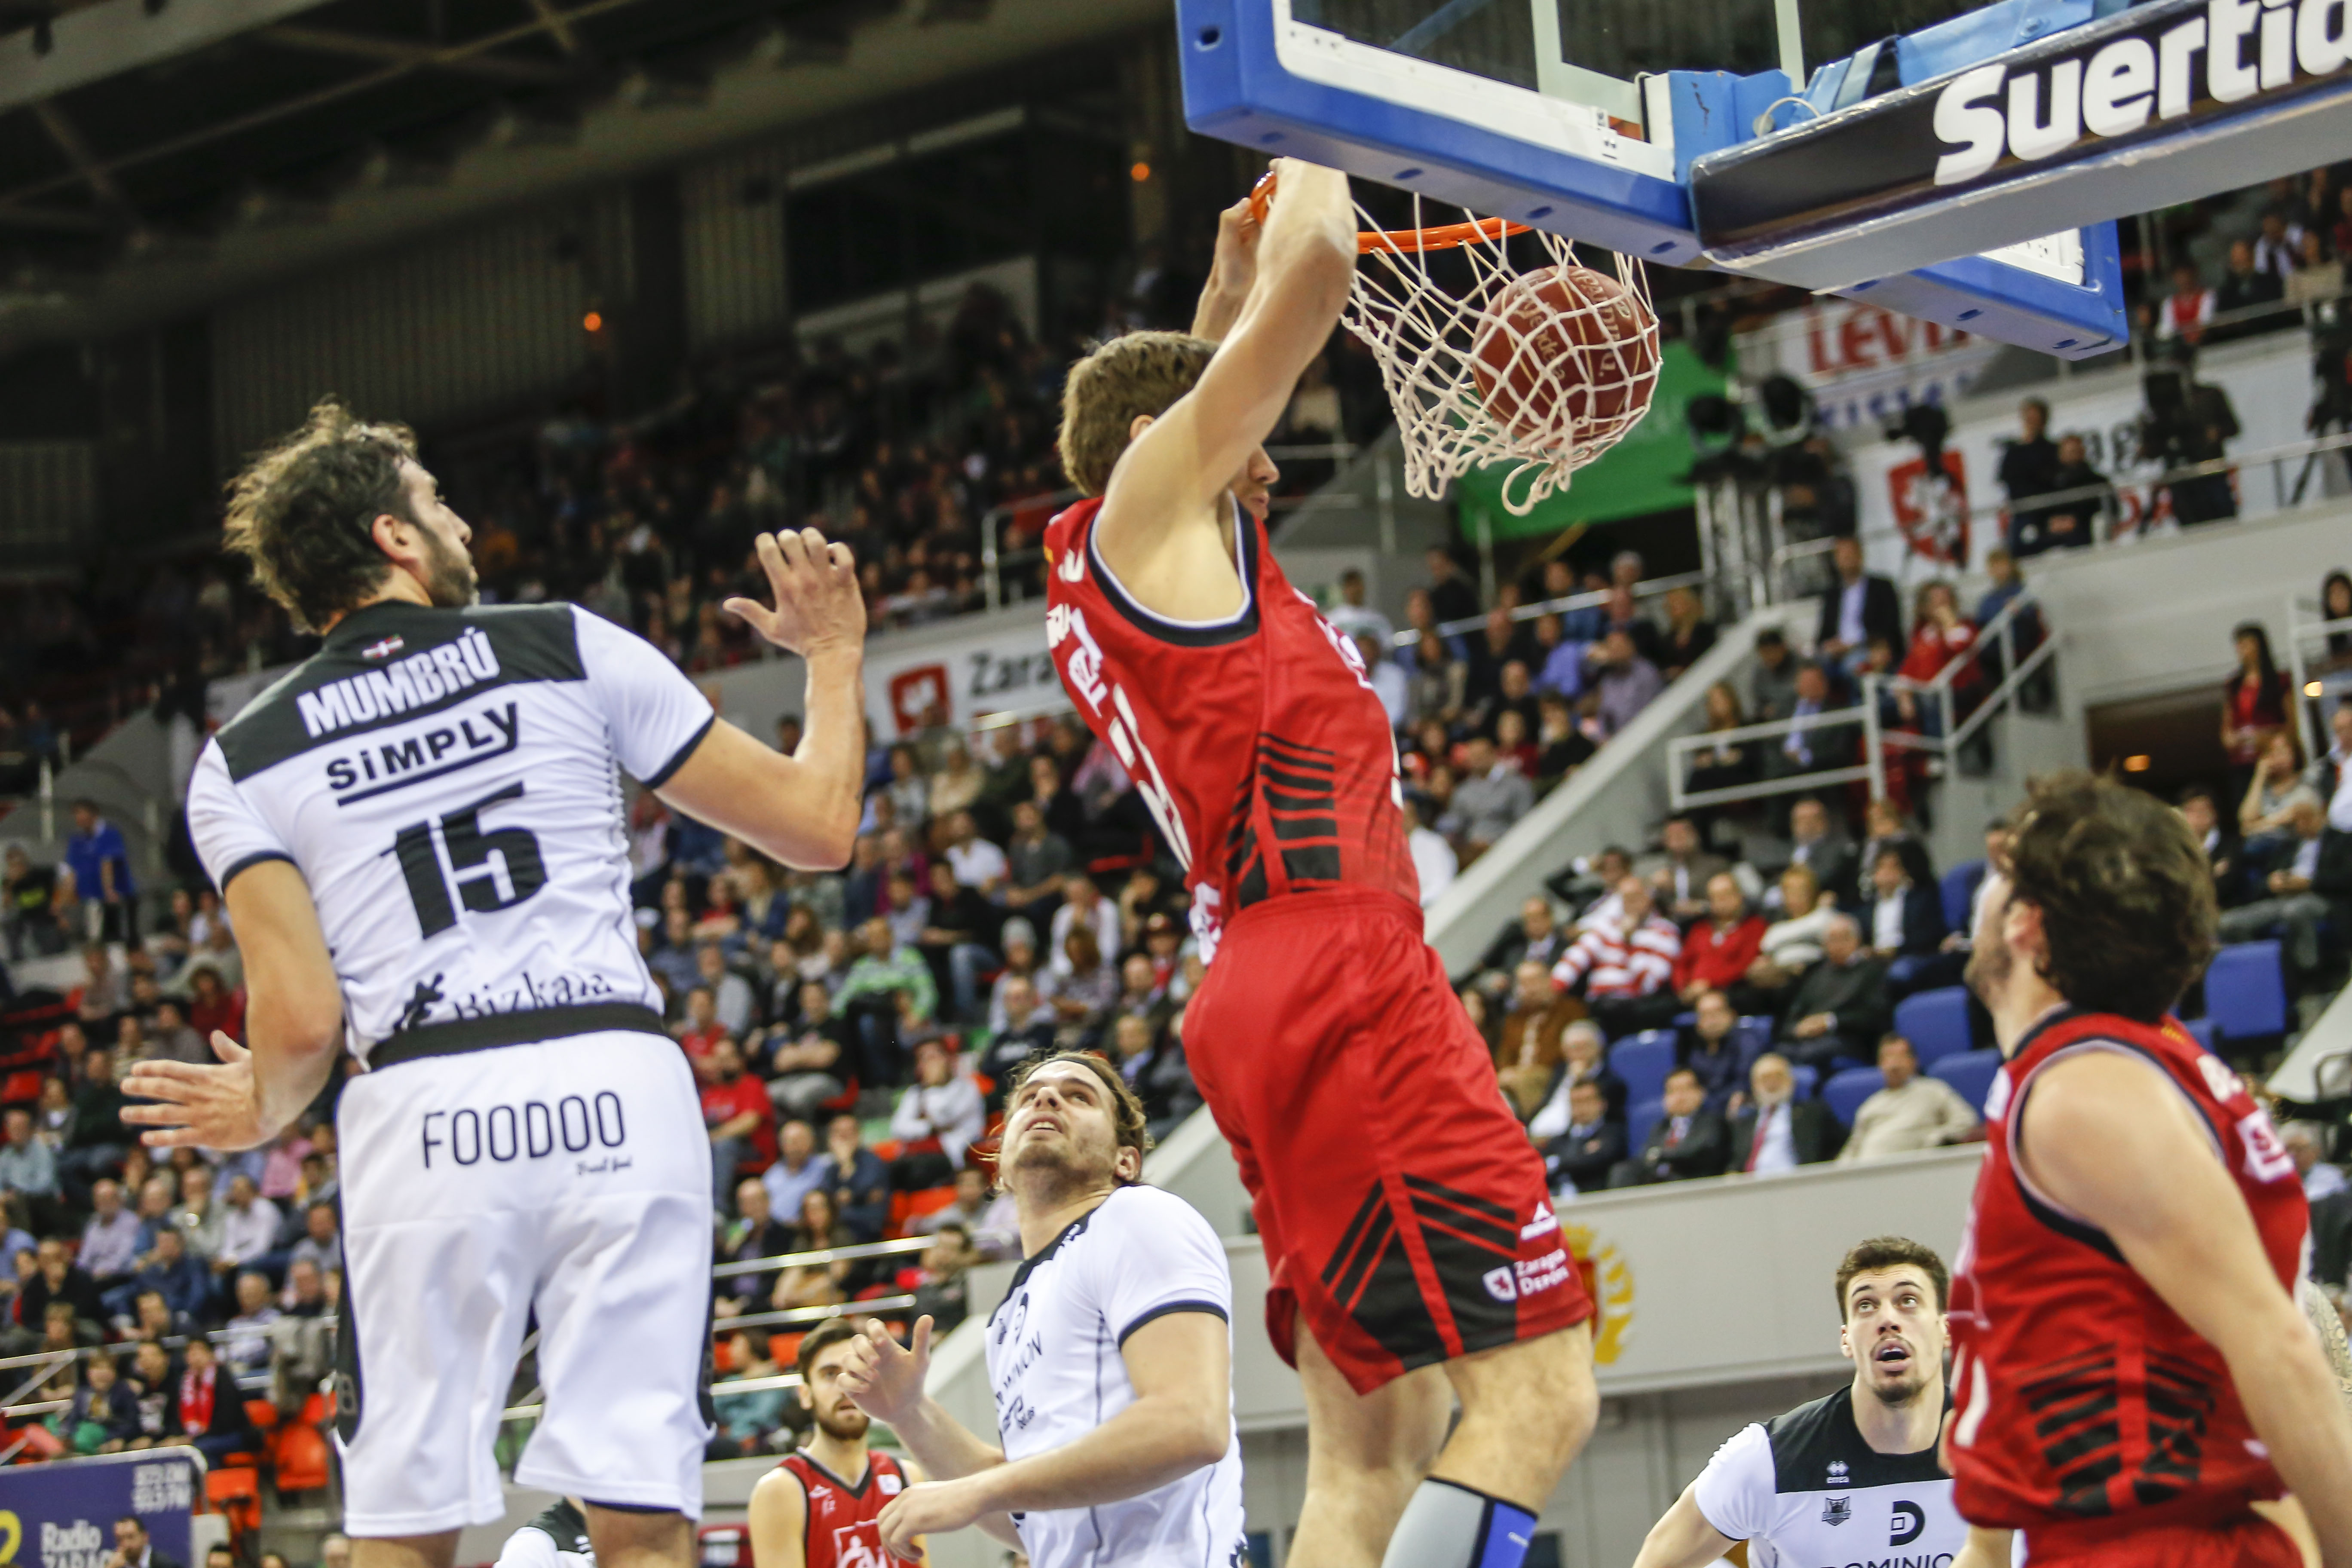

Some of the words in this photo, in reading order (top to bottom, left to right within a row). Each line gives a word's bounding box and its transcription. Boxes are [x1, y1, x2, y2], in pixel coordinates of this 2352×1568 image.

[296, 626, 500, 738] MUMBRÚ
[380, 781, 548, 940] 15
[423, 1091, 625, 1168] FOODOO
[40, 1519, 102, 1552] Radio
